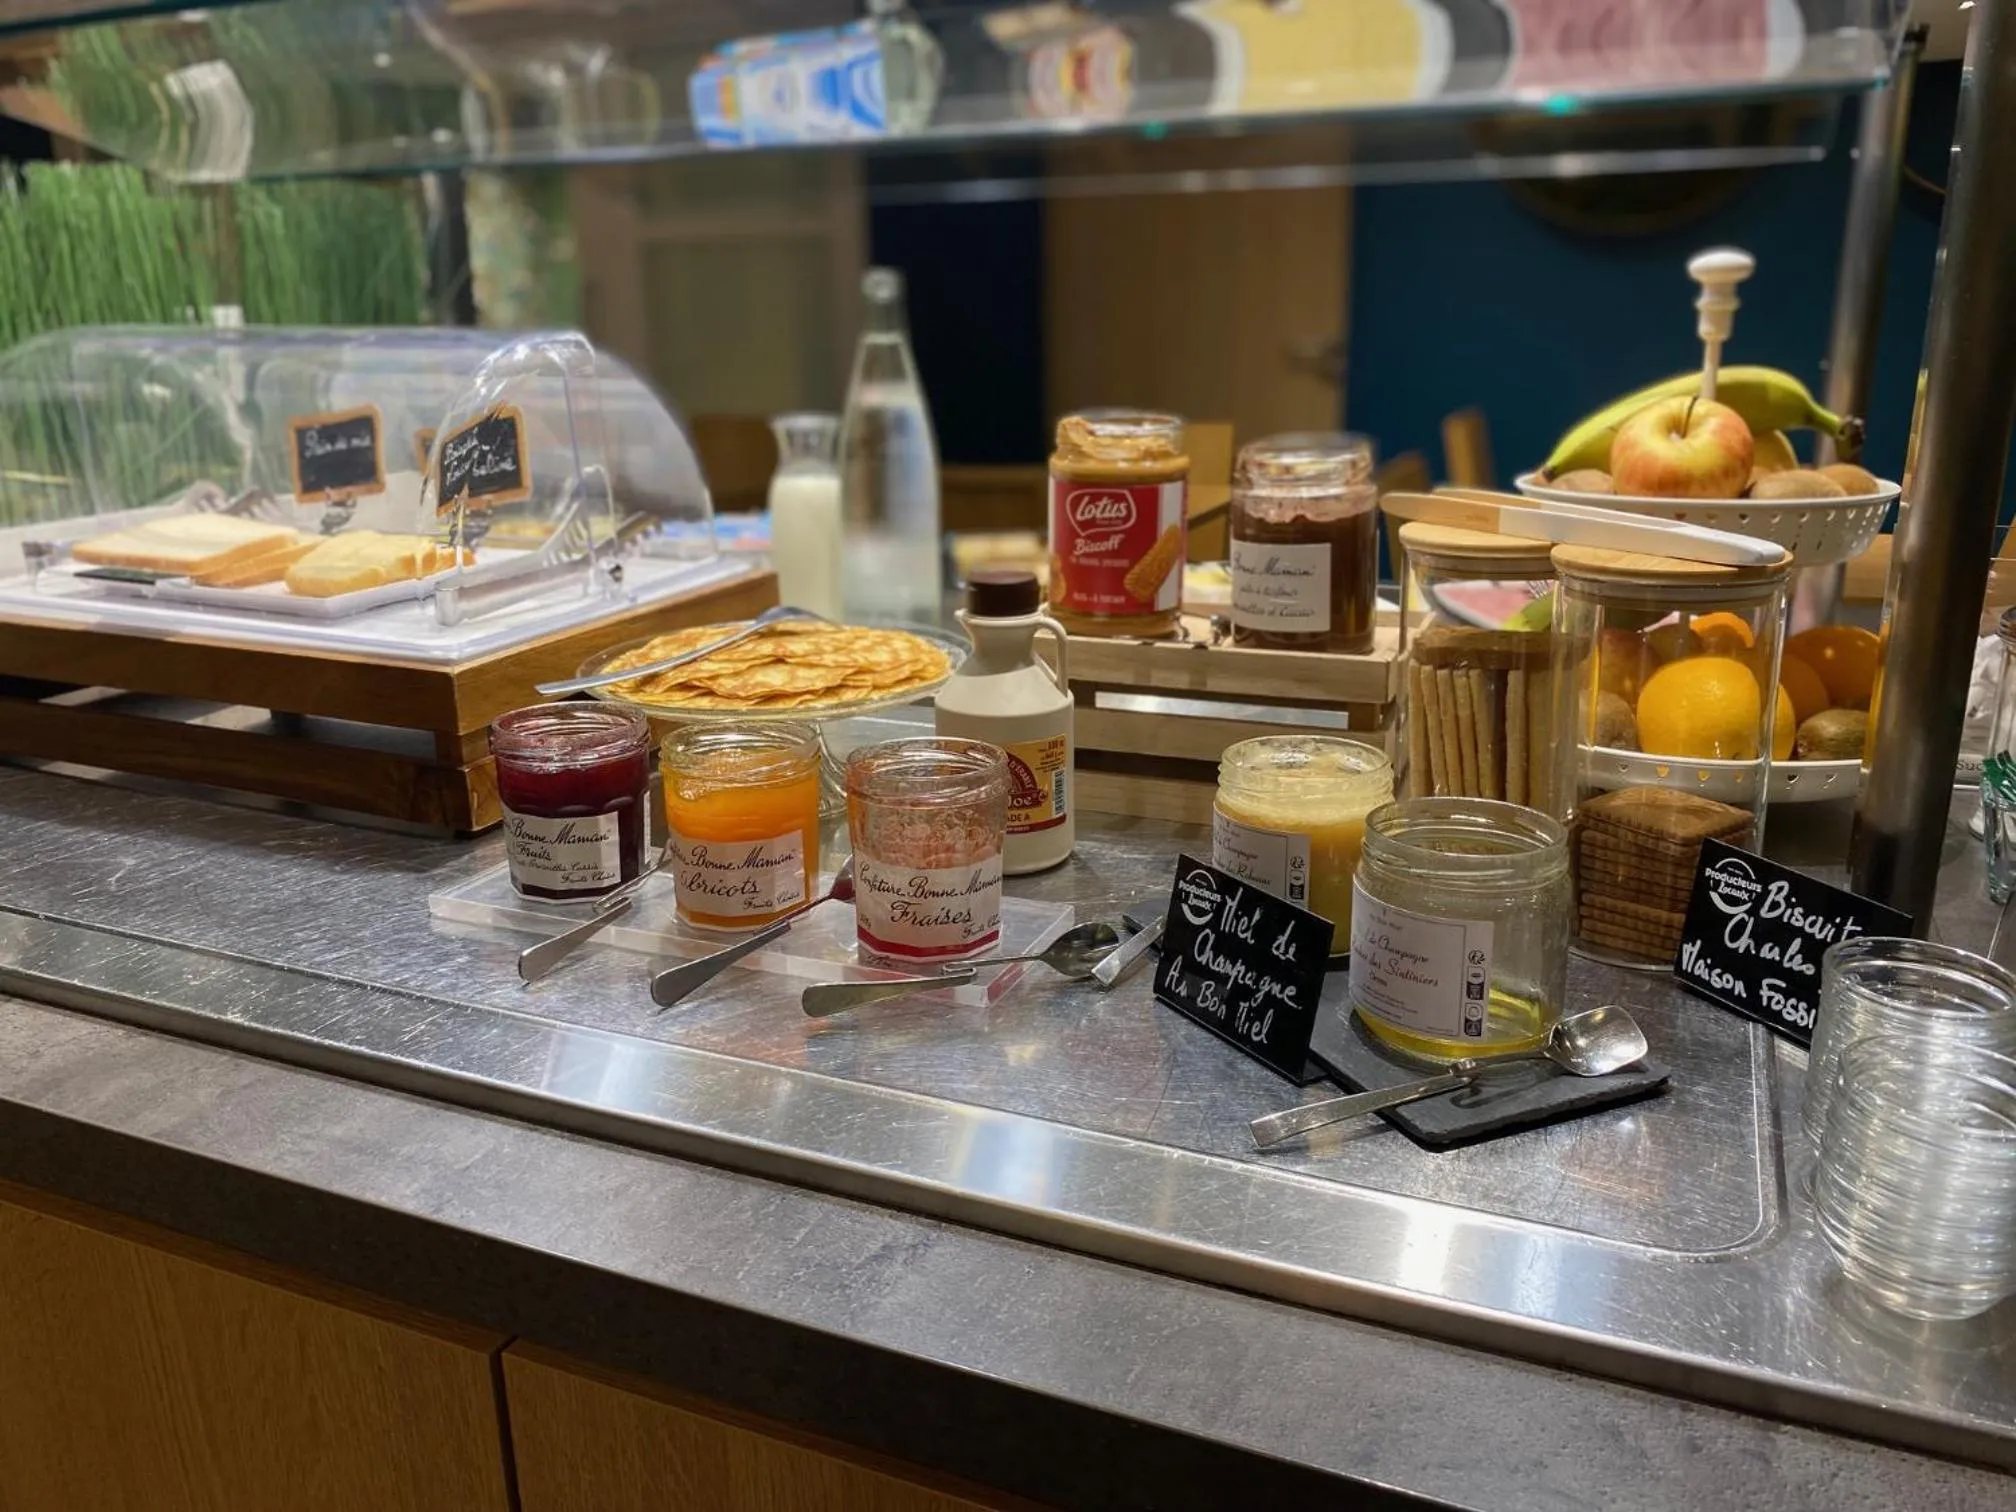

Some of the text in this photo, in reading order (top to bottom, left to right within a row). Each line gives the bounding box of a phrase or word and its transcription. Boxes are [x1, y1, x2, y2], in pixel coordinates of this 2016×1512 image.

[1076, 496, 1127, 520] Lotus
[1073, 534, 1125, 555] Biscoff
[511, 817, 549, 844] Bonne
[550, 822, 610, 845] Maman
[516, 842, 552, 861] Fruits
[691, 844, 736, 871] Bonne
[737, 846, 794, 870] Maman
[860, 860, 905, 896] Confiture
[907, 875, 957, 899] Bonne
[1178, 879, 1222, 902] Producteurs
[1705, 867, 1763, 892] Producteurs
[890, 900, 972, 927] Fraises
[1220, 887, 1297, 962] Miel de
[1759, 880, 1864, 943] Biscuit
[1724, 912, 1816, 975] Charles
[1193, 928, 1302, 1010] Champagne
[1681, 939, 1747, 998] Maison
[1165, 955, 1275, 1044] Au Bon Miel
